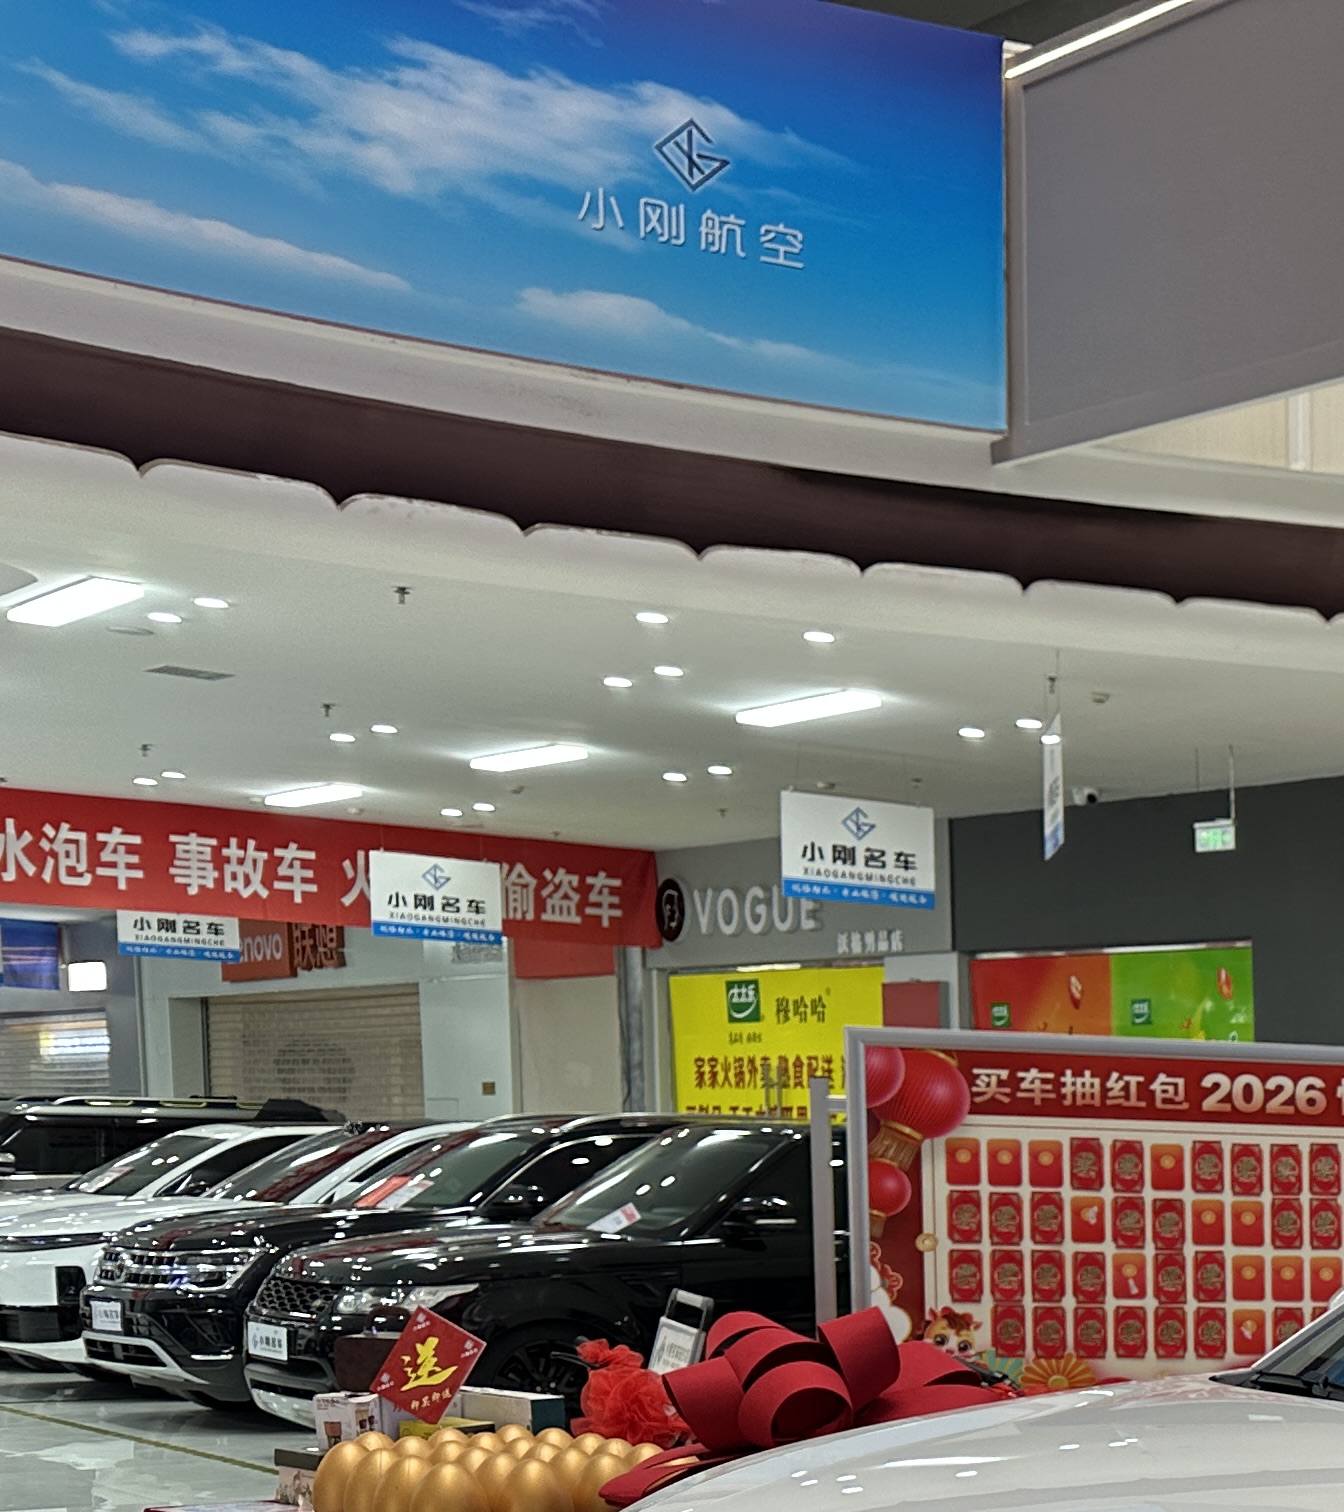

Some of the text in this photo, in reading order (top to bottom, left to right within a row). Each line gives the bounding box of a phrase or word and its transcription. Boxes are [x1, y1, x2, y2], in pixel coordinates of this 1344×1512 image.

[578, 187, 804, 269] 小刚航空
[169, 832, 318, 903] 事故车
[801, 842, 918, 871] 小刚名车
[132, 917, 225, 936] 小刚名车
[387, 891, 486, 915] 小刚名车
[694, 884, 820, 935] VOGUE
[971, 1067, 1190, 1112] 买车抽红包
[1201, 1072, 1328, 1115] 2026
[400, 1336, 459, 1392] 送
